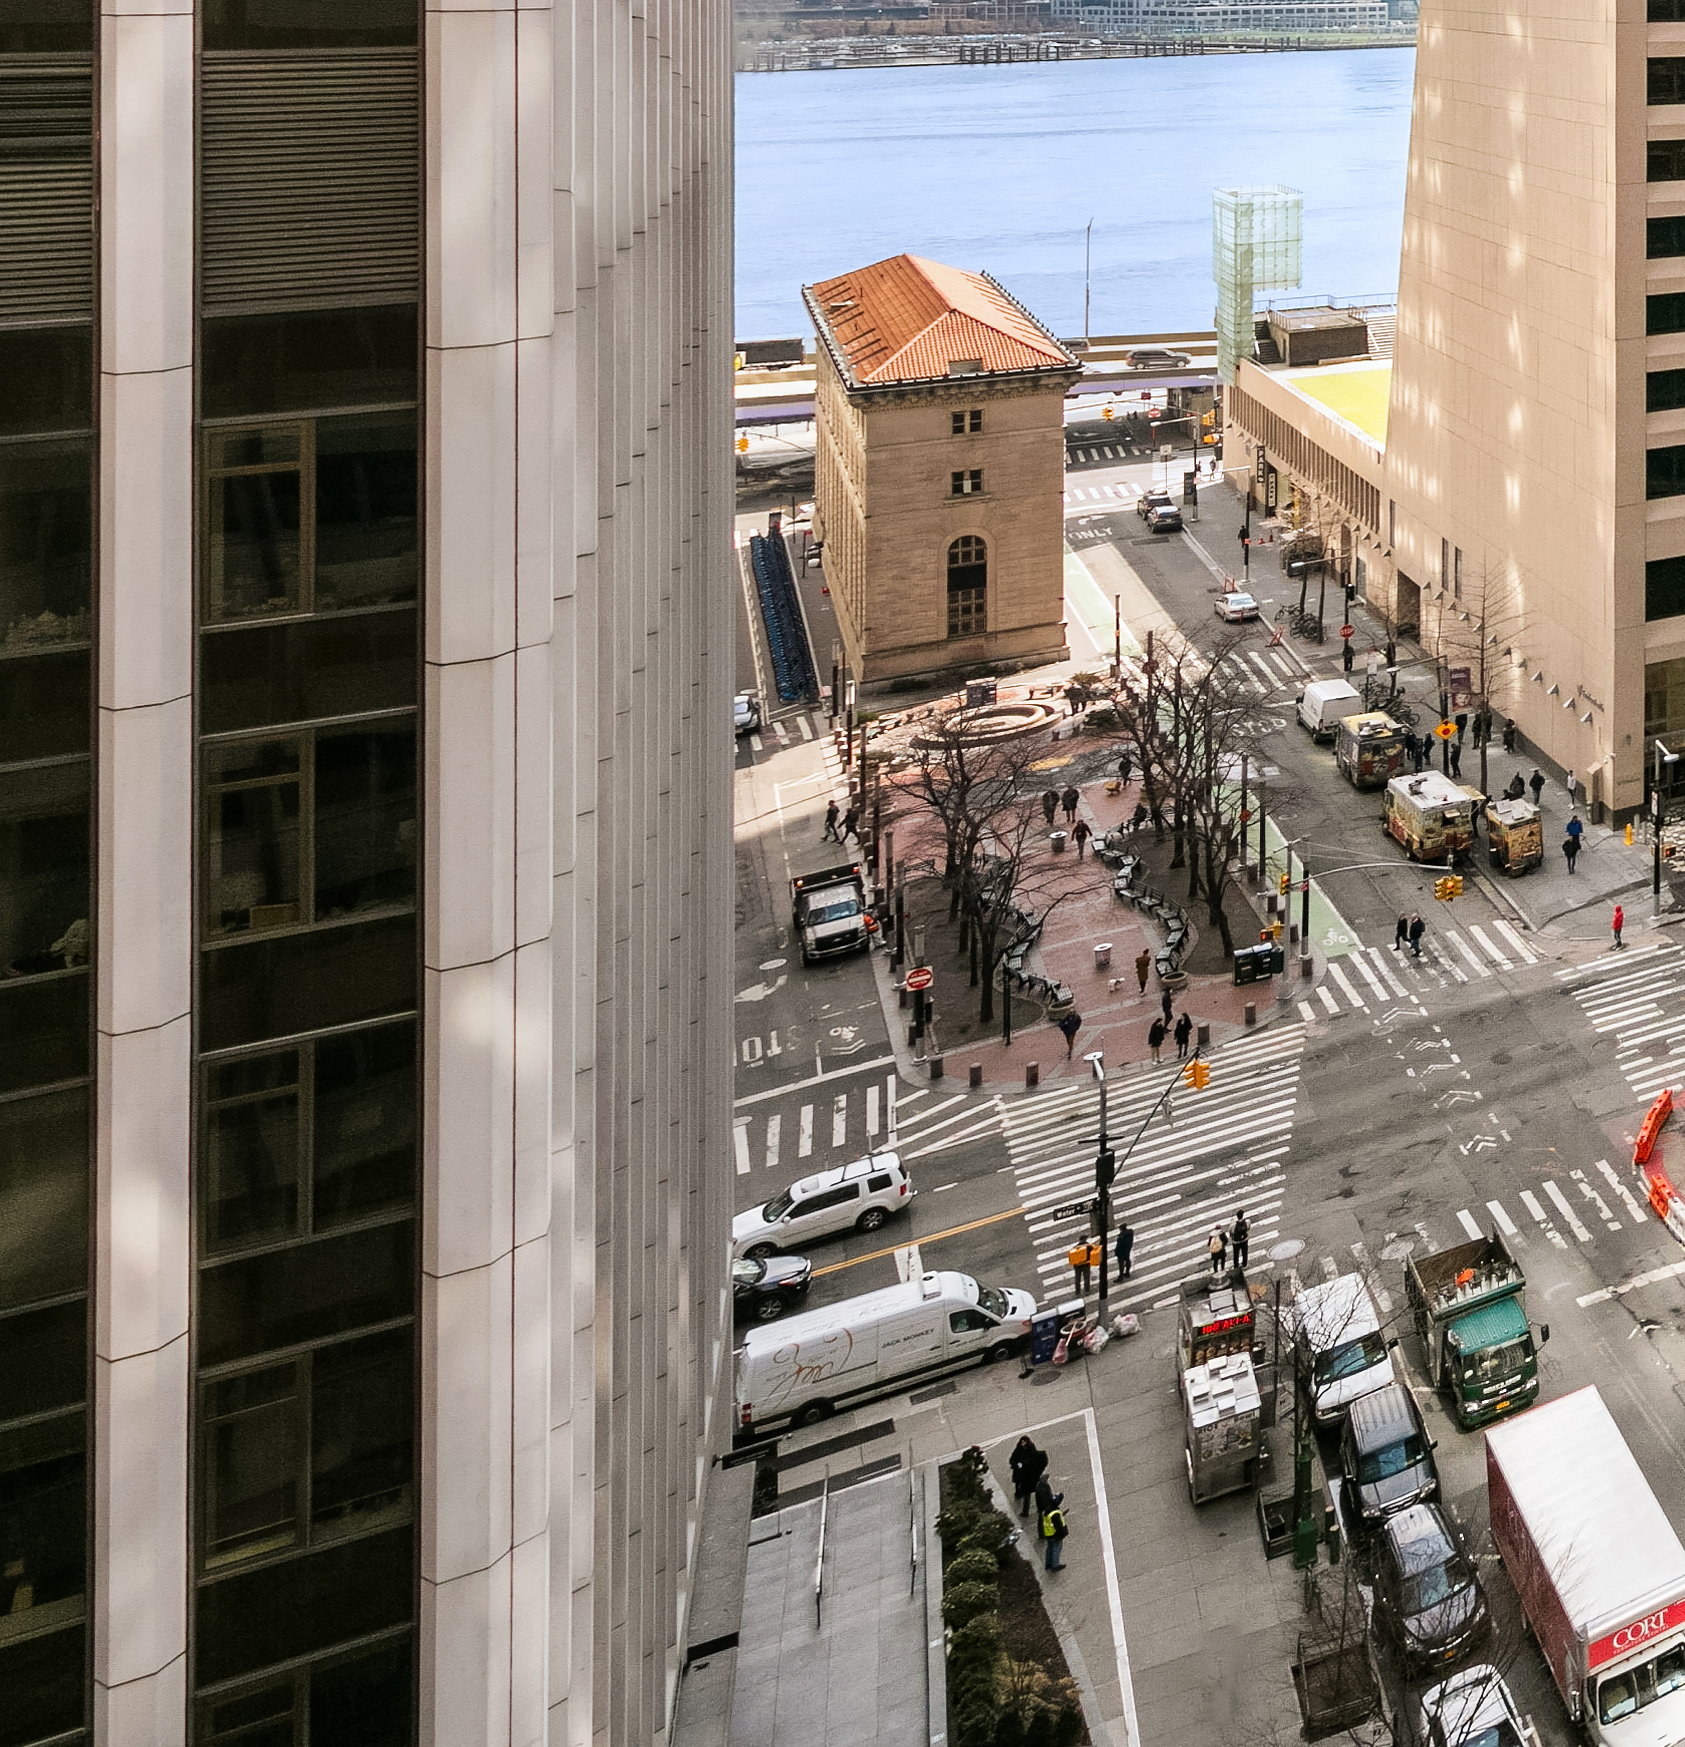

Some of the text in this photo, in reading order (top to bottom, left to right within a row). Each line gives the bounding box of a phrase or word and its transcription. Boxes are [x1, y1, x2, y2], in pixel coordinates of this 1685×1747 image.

[1257, 450, 1265, 476] PARK
[1068, 527, 1113, 540] ONLY
[1231, 718, 1287, 737] STOP
[903, 1327, 935, 1343] MONKEY
[1612, 1609, 1667, 1649] CORT
